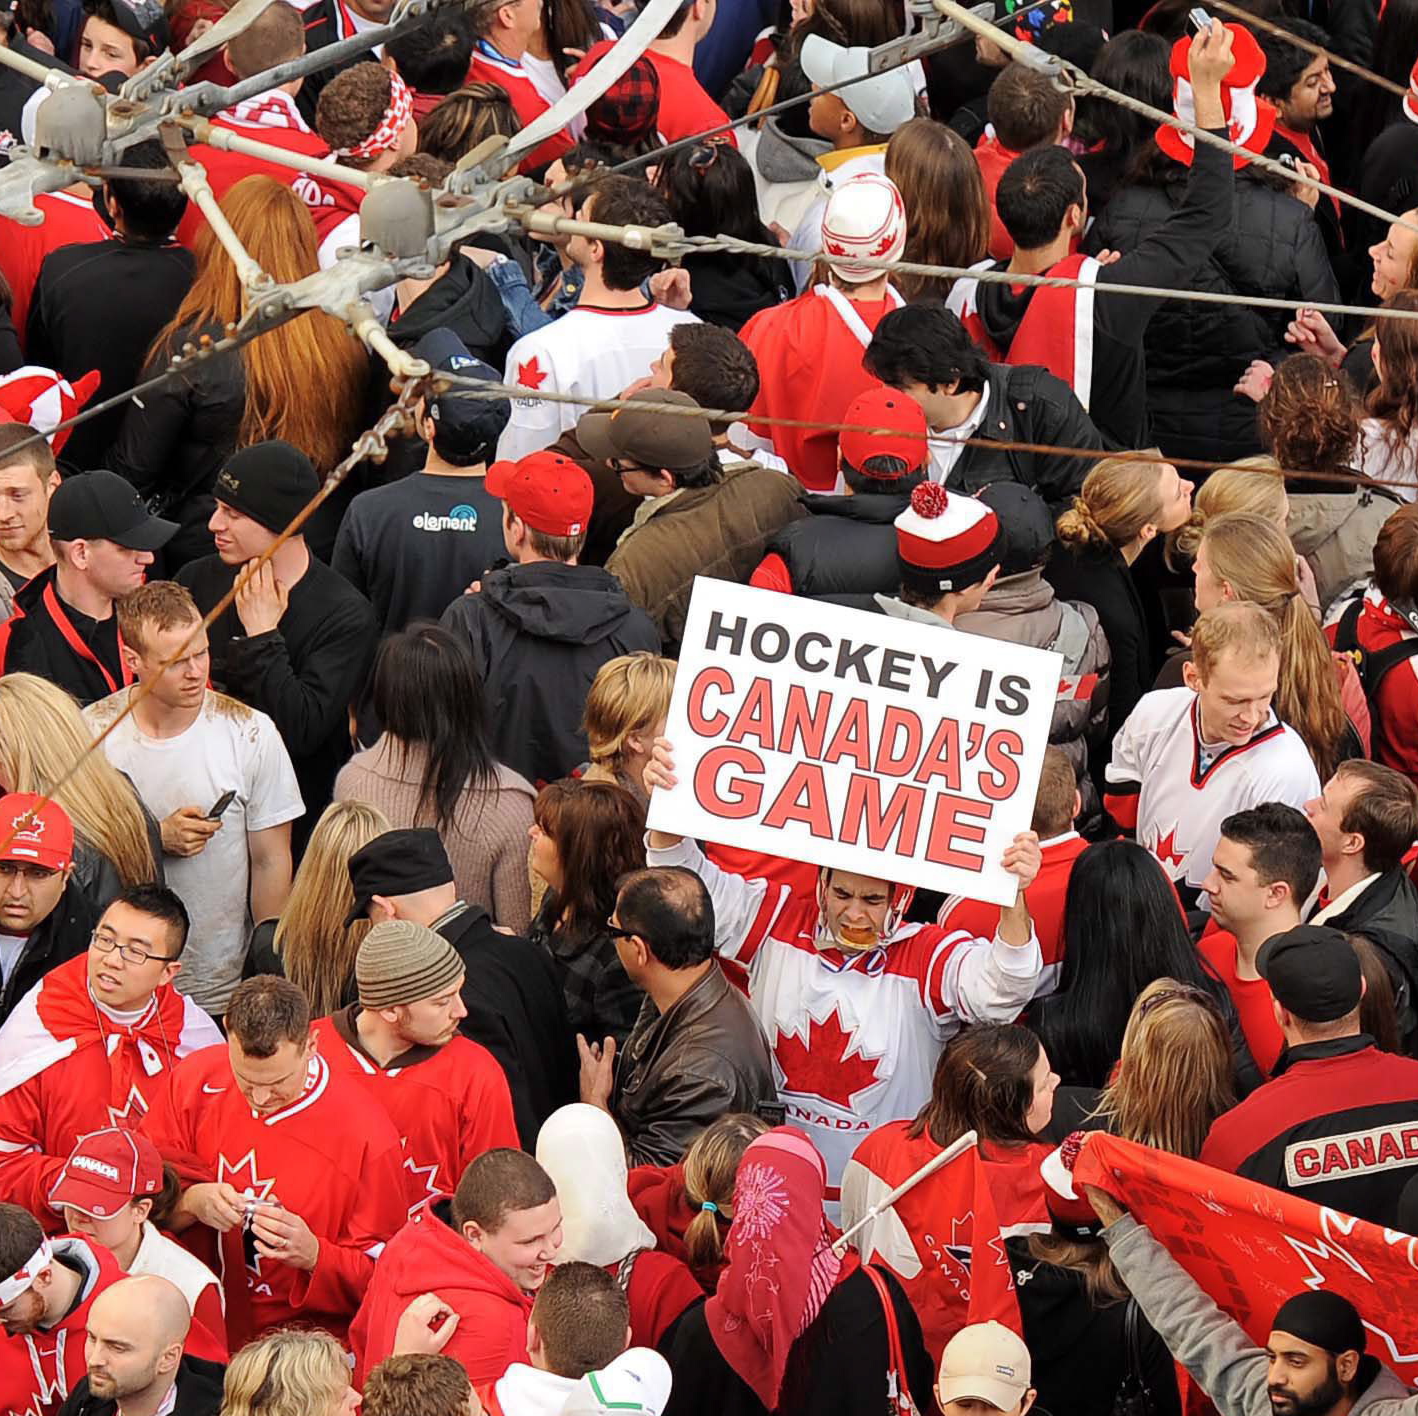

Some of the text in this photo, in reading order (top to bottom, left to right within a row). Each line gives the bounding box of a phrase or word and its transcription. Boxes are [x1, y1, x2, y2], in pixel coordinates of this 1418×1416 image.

[704, 610, 1033, 716] HOCKEY IS
[686, 665, 1024, 802] CANADA'S
[693, 744, 994, 874] GAME
[72, 1155, 120, 1182] CANADA
